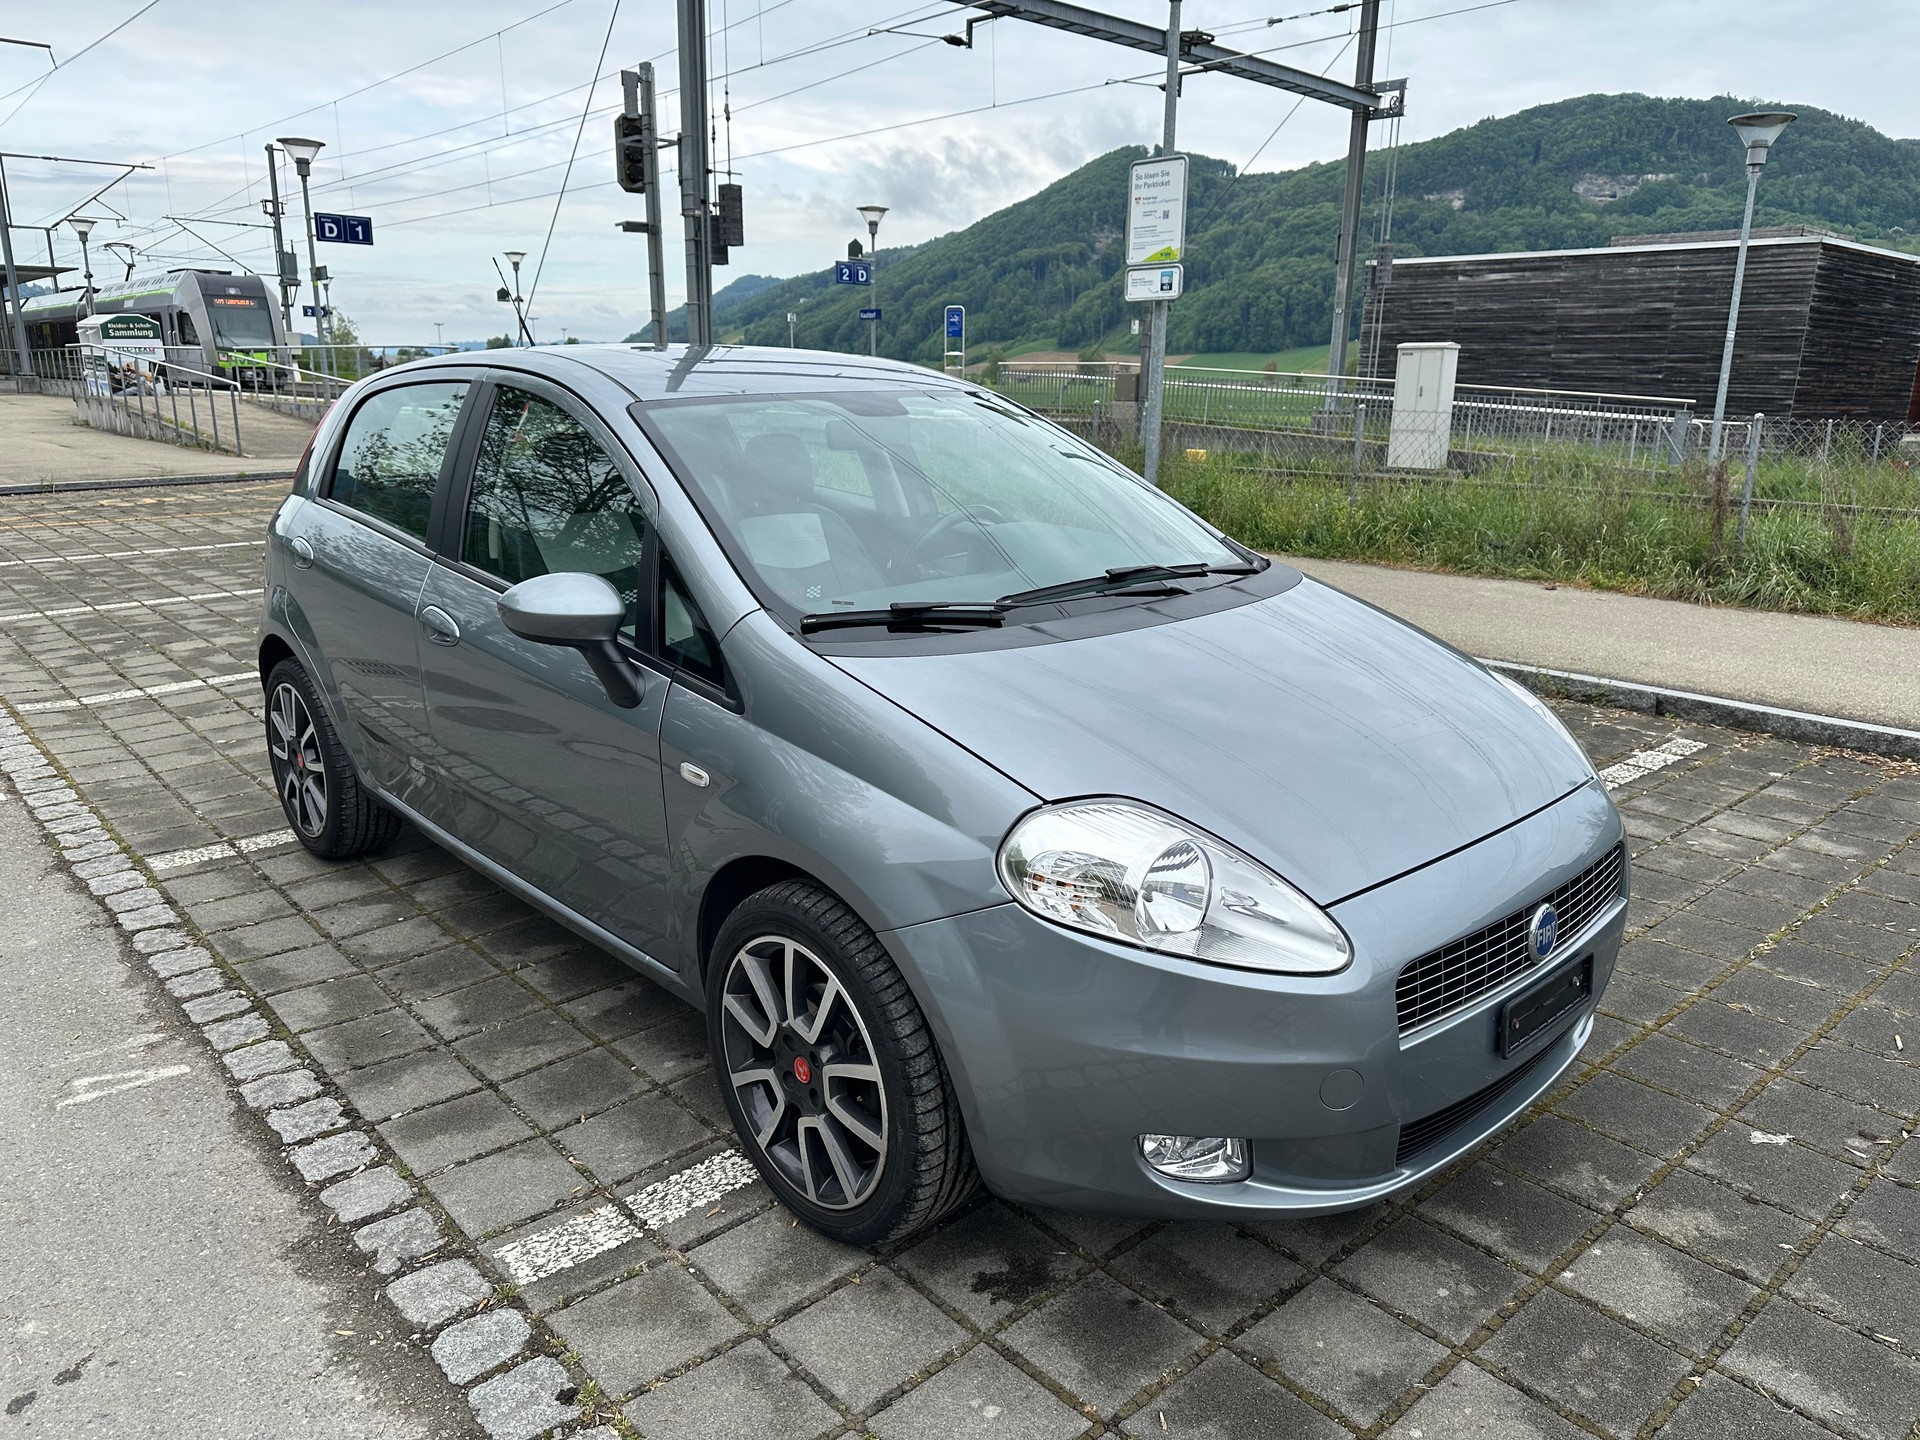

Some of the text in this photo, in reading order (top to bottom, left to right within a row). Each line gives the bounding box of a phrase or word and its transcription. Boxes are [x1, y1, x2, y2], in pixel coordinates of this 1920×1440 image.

[1135, 170, 1170, 181] So lösen Sie
[1144, 180, 1171, 189] Parkticket
[324, 222, 363, 240] D 1
[842, 268, 867, 281] 2 D
[108, 329, 154, 337] Sammlung
[1536, 920, 1556, 948] FIAT
